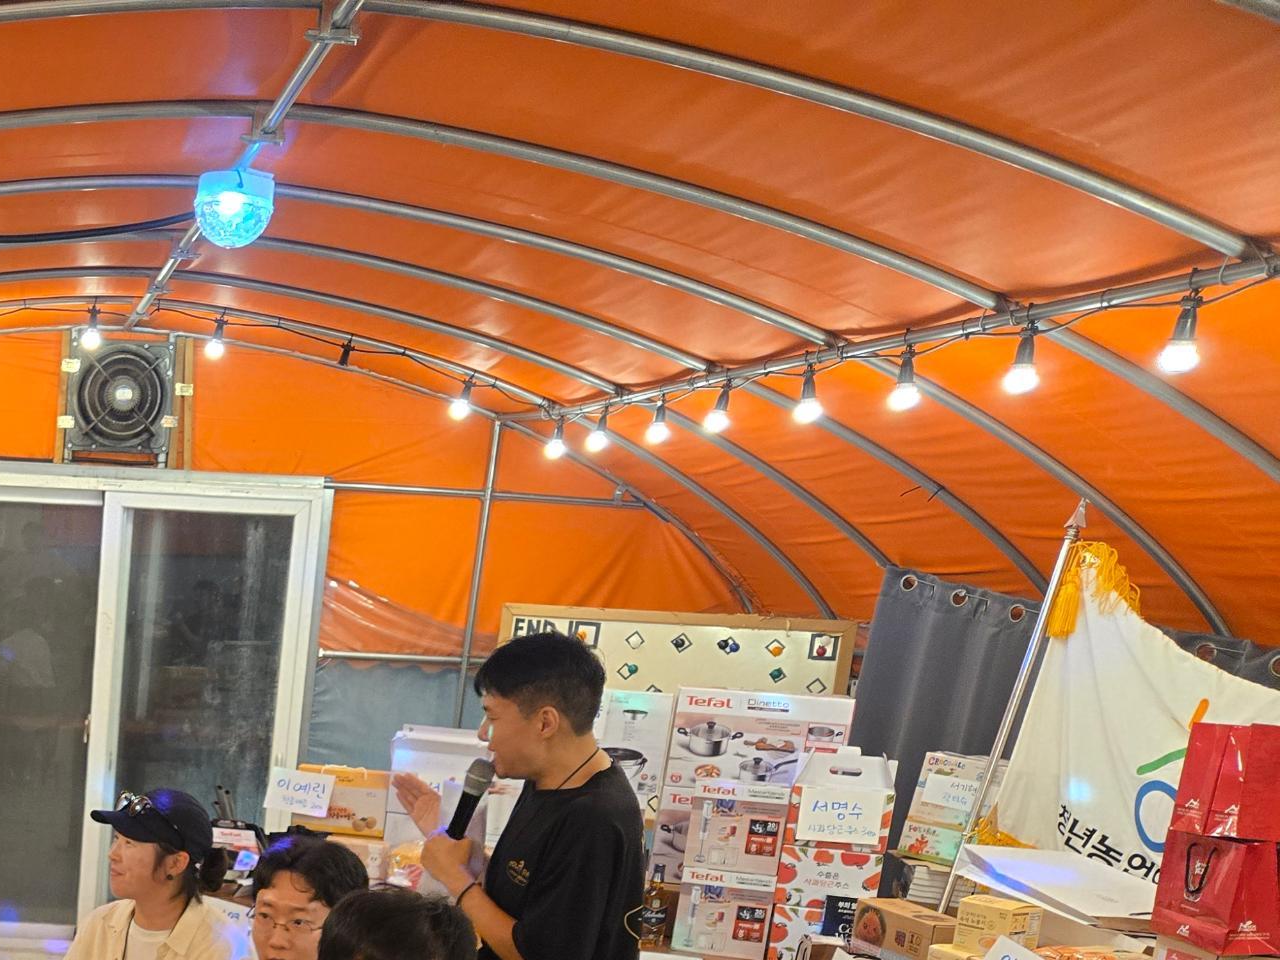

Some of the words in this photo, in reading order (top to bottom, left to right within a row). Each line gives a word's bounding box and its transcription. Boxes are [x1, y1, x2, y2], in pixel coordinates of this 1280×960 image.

[687, 695, 733, 709] Tefal
[277, 778, 326, 799] 이예린
[701, 785, 737, 796] Tefal
[812, 799, 863, 821] 서명수
[689, 871, 727, 883] Tefal
